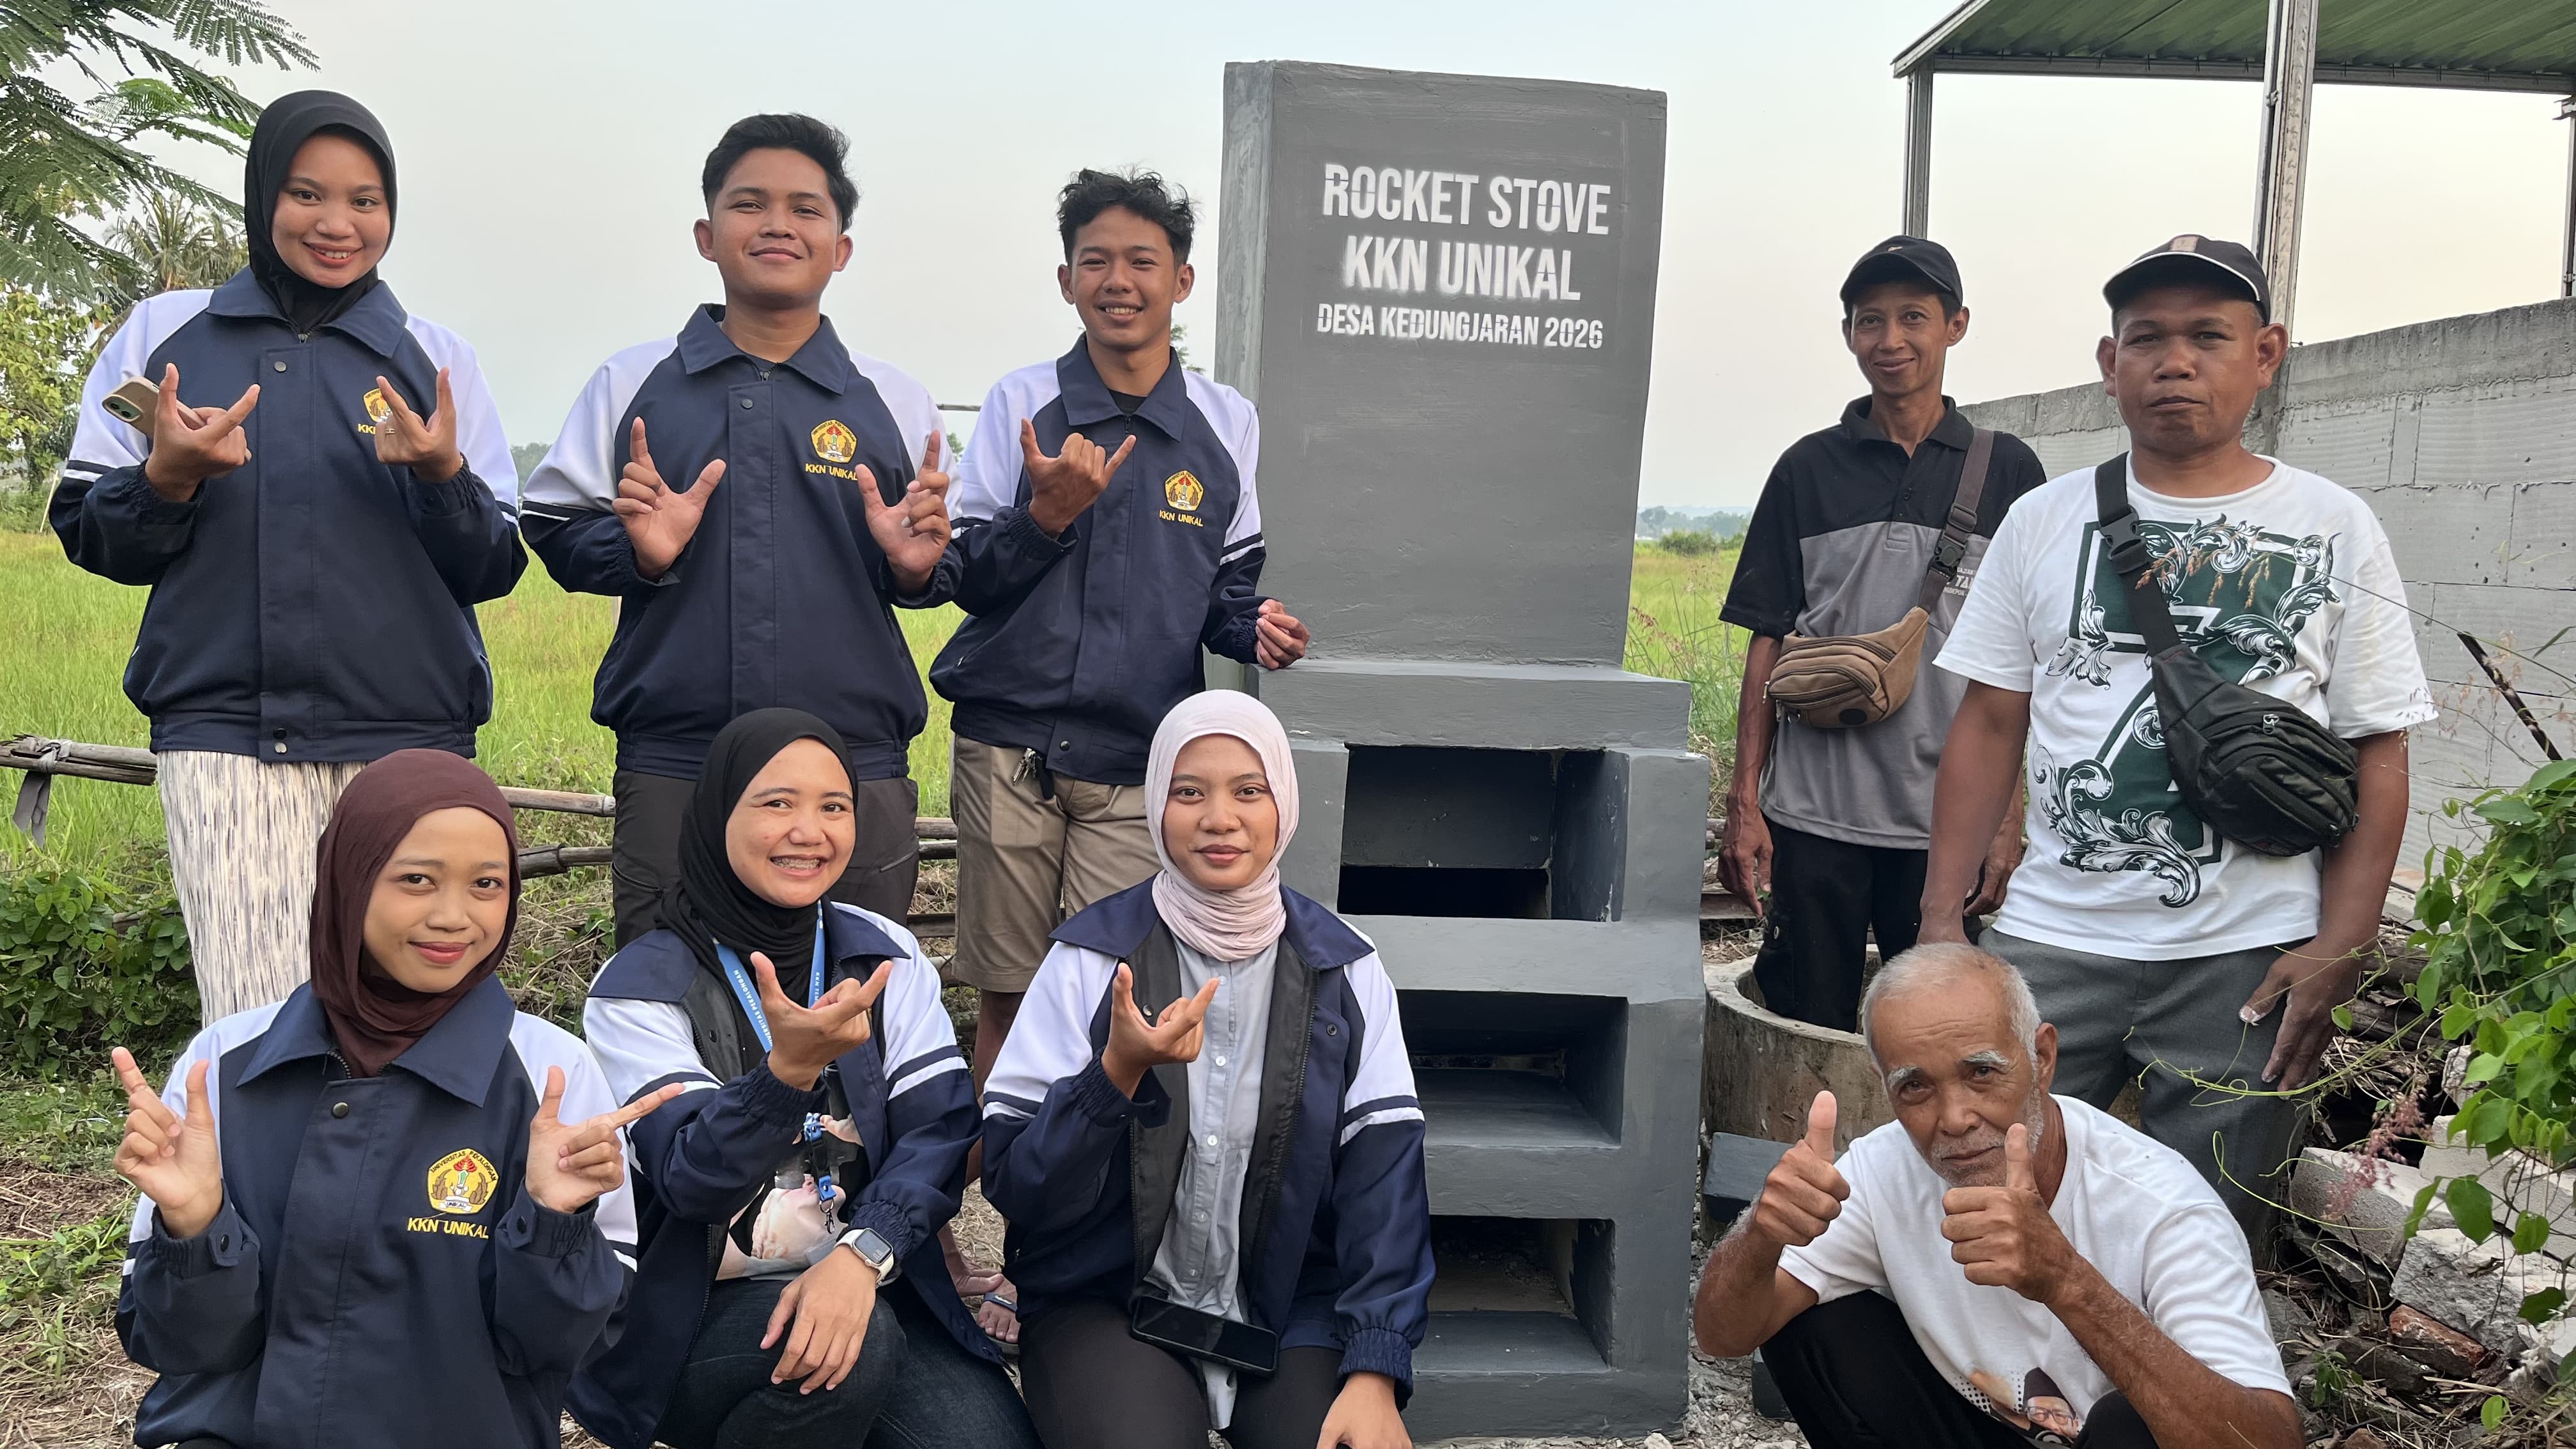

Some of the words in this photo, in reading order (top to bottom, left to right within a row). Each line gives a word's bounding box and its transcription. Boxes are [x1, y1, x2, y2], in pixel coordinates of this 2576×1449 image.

[1322, 164, 1479, 225] ROCKET
[1488, 176, 1611, 234] STOVE
[1345, 235, 1427, 291] KKN
[1439, 241, 1581, 301] UNIKAL
[1317, 303, 1375, 335] DESA
[1381, 307, 1538, 345] KEDUNGJARAN
[1544, 317, 1603, 349] 2026
[805, 463, 826, 473] KKN
[829, 466, 857, 481] UNIKAL
[1159, 509, 1175, 521] KKN
[1177, 514, 1204, 527] UNIKAL
[755, 1011, 773, 1046] NIVERSITAS
[430, 1151, 466, 1173] UNIVERSITAS
[469, 1151, 497, 1181] PEKALONGAN
[407, 1217, 439, 1232] KKN
[443, 1220, 489, 1239] UNIKAL
